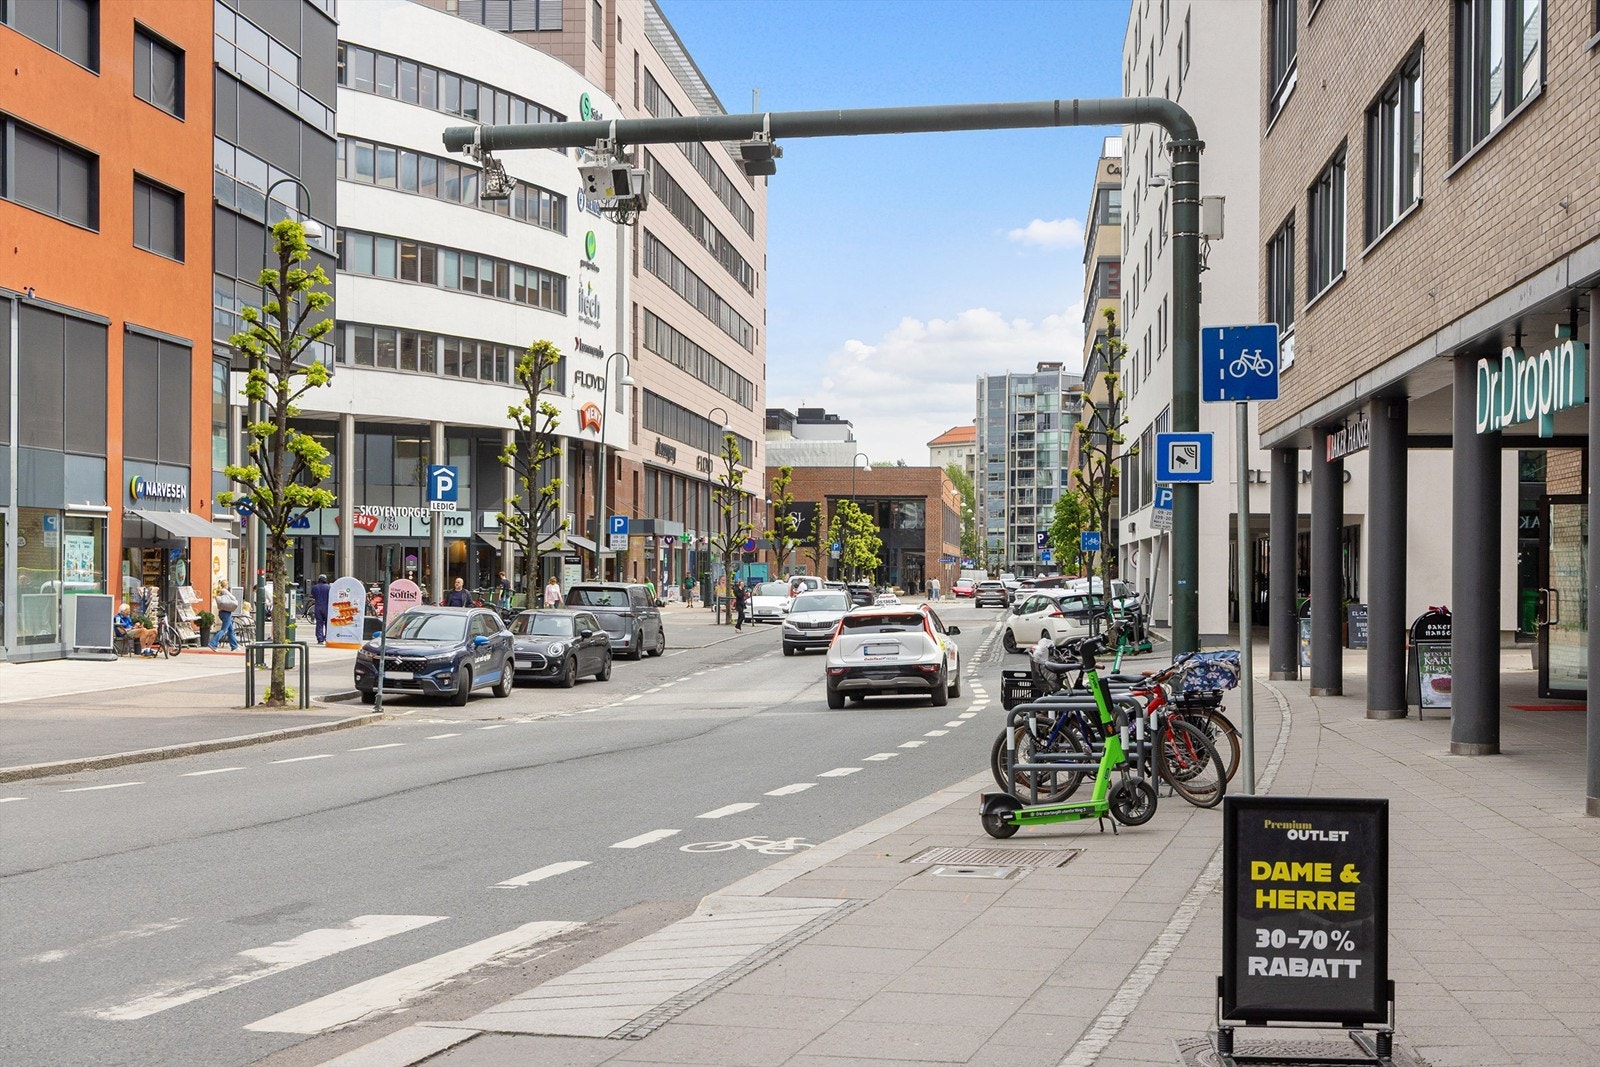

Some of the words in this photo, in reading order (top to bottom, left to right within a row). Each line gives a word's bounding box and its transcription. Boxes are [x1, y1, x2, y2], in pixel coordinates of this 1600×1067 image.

[574, 370, 605, 392] FLOYD
[145, 481, 187, 499] NARVESEN
[437, 476, 453, 499] P
[1160, 490, 1173, 506] P
[432, 502, 455, 511] LEDIG
[353, 515, 374, 527] ENY
[614, 518, 624, 532] P
[389, 590, 417, 600] softis!
[1264, 819, 1312, 830] Premium
[1287, 829, 1349, 842] OUTLET
[1250, 861, 1332, 882] DAME
[1339, 861, 1361, 884] &
[1255, 889, 1356, 911] HERRE
[1248, 956, 1362, 979] RABATT
